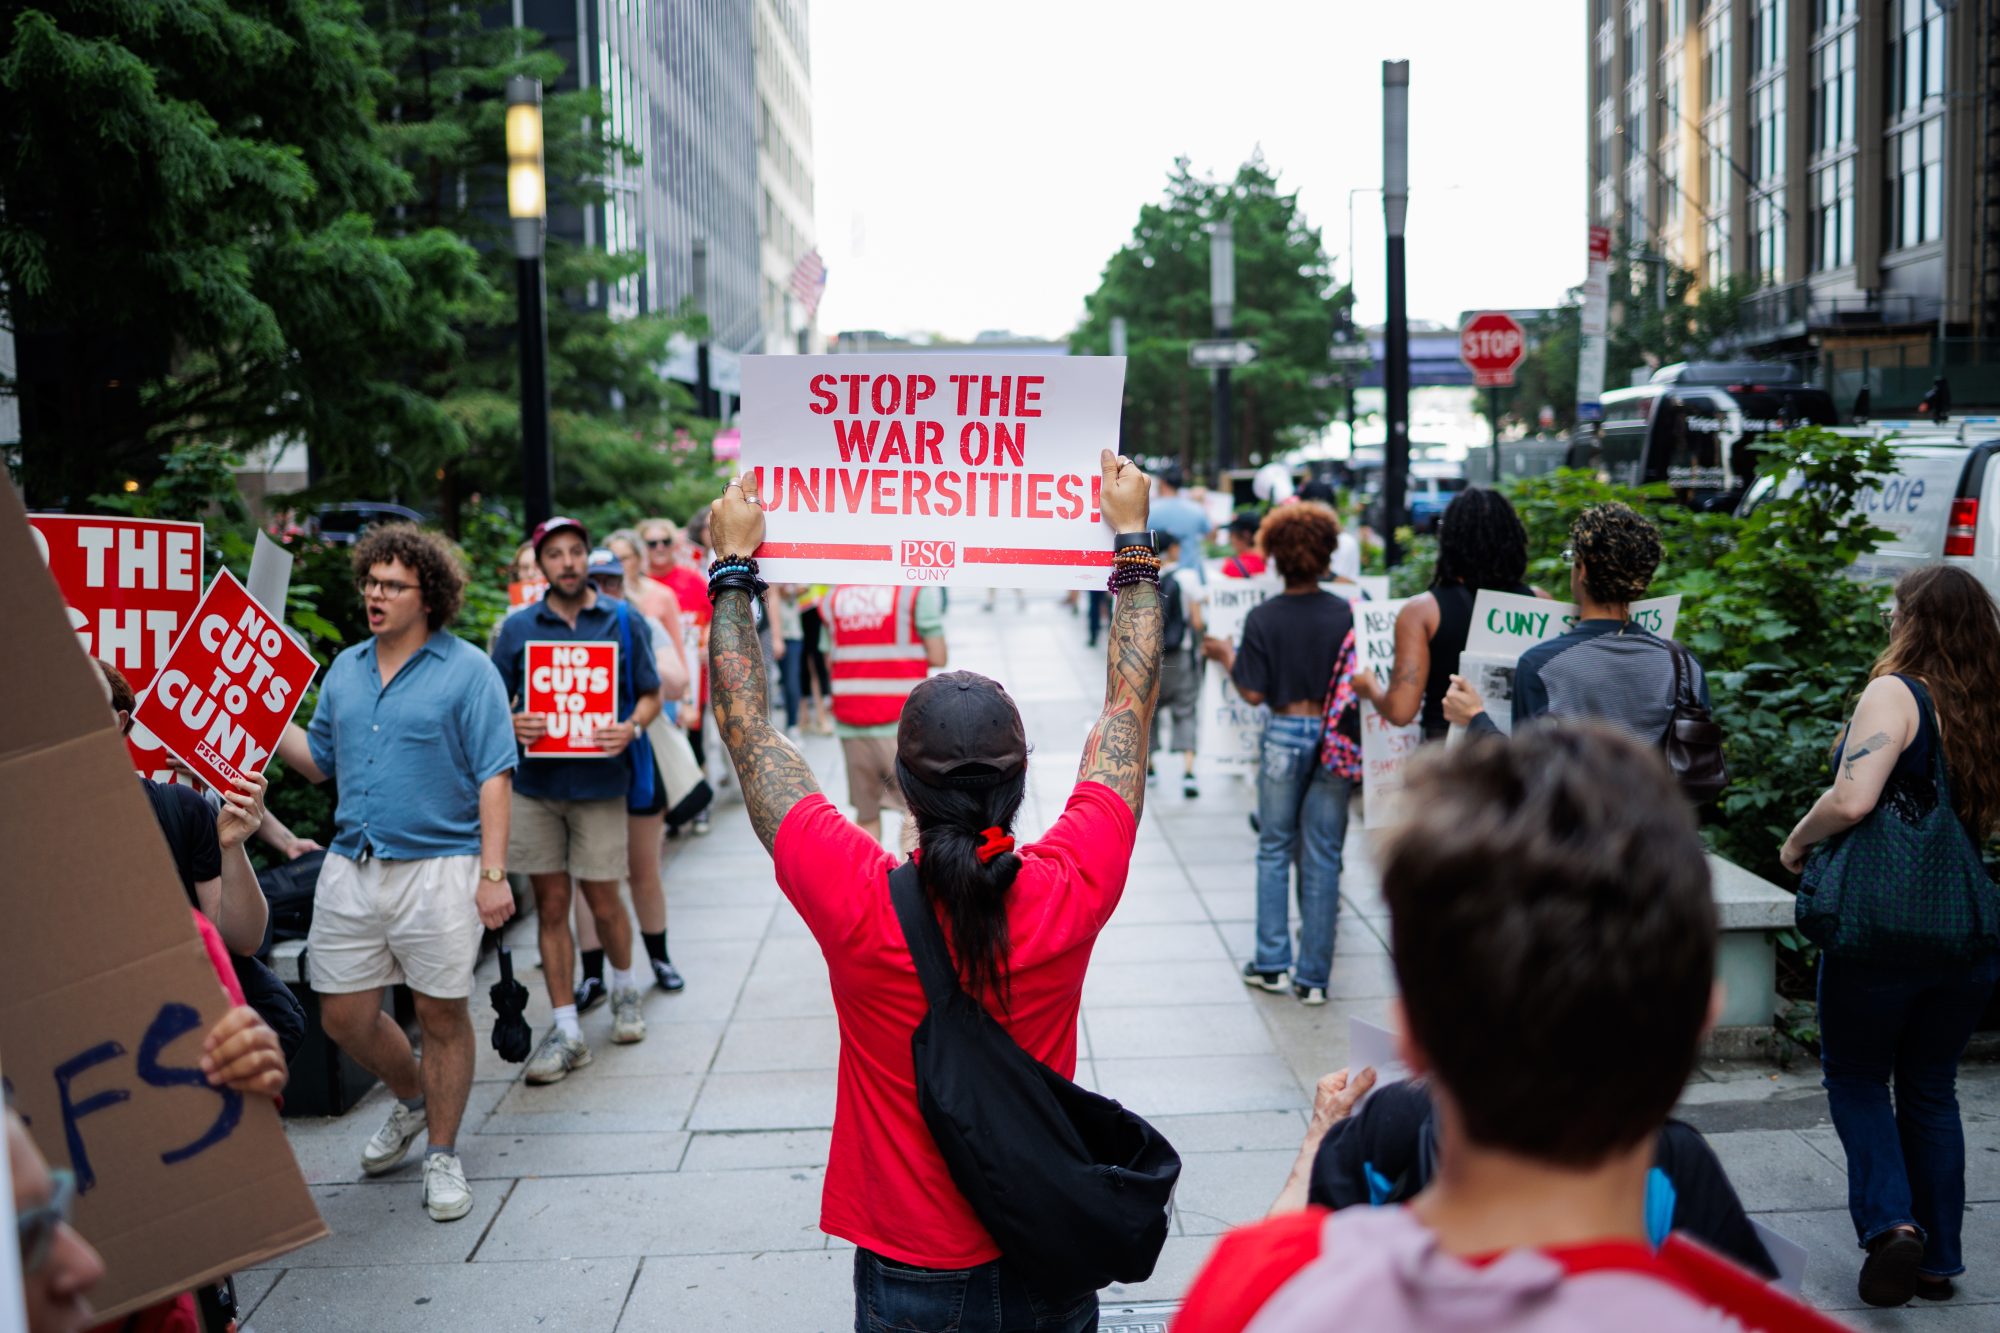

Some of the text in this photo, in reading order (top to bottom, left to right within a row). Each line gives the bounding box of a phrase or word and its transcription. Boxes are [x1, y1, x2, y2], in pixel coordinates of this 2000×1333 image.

[1463, 330, 1519, 359] STOP
[809, 374, 1045, 417] STOP THE
[834, 420, 1026, 467] WAR ON
[754, 466, 1101, 523] UNIVERSITIES!
[78, 526, 193, 591] THE
[902, 540, 955, 568] PSC
[906, 569, 949, 581] CUNY
[237, 605, 282, 658] NO
[1487, 608, 1549, 638] CUNY
[199, 613, 292, 713] CUTS
[552, 647, 589, 667] NO
[209, 666, 248, 715] TO
[532, 665, 609, 694] CUTS
[157, 669, 268, 773] CUNY
[554, 693, 586, 713] TO
[534, 712, 613, 739] UNY
[196, 742, 242, 783] PSC/CUN
